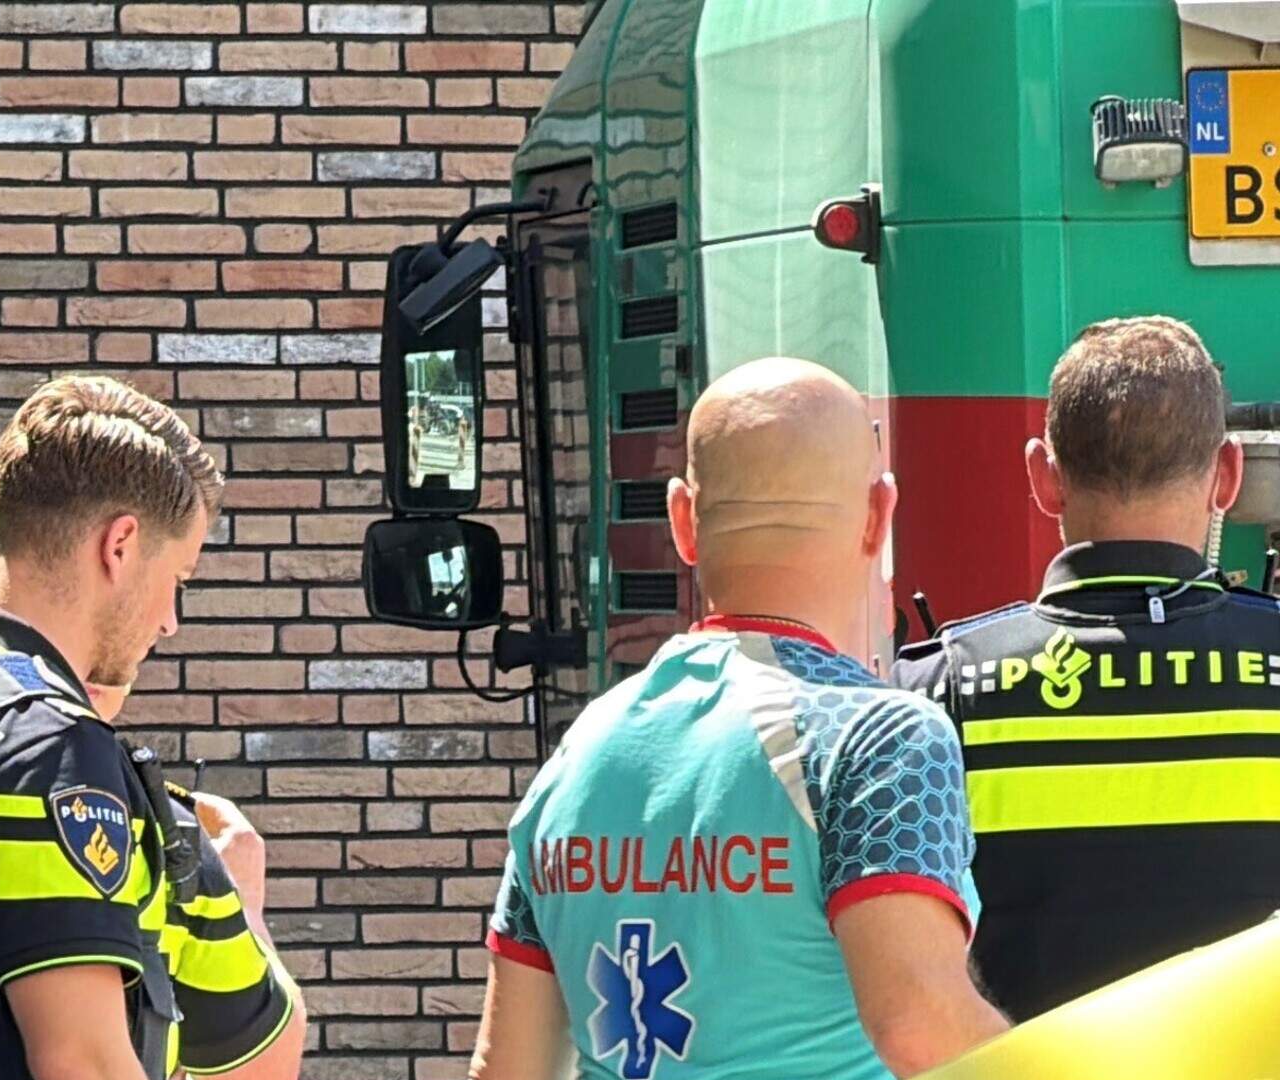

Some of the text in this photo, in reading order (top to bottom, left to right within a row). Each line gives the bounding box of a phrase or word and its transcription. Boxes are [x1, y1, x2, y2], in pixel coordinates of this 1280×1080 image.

[1195, 122, 1225, 141] NL
[1001, 626, 1265, 709] POLITIE
[61, 796, 124, 826] POLITIE
